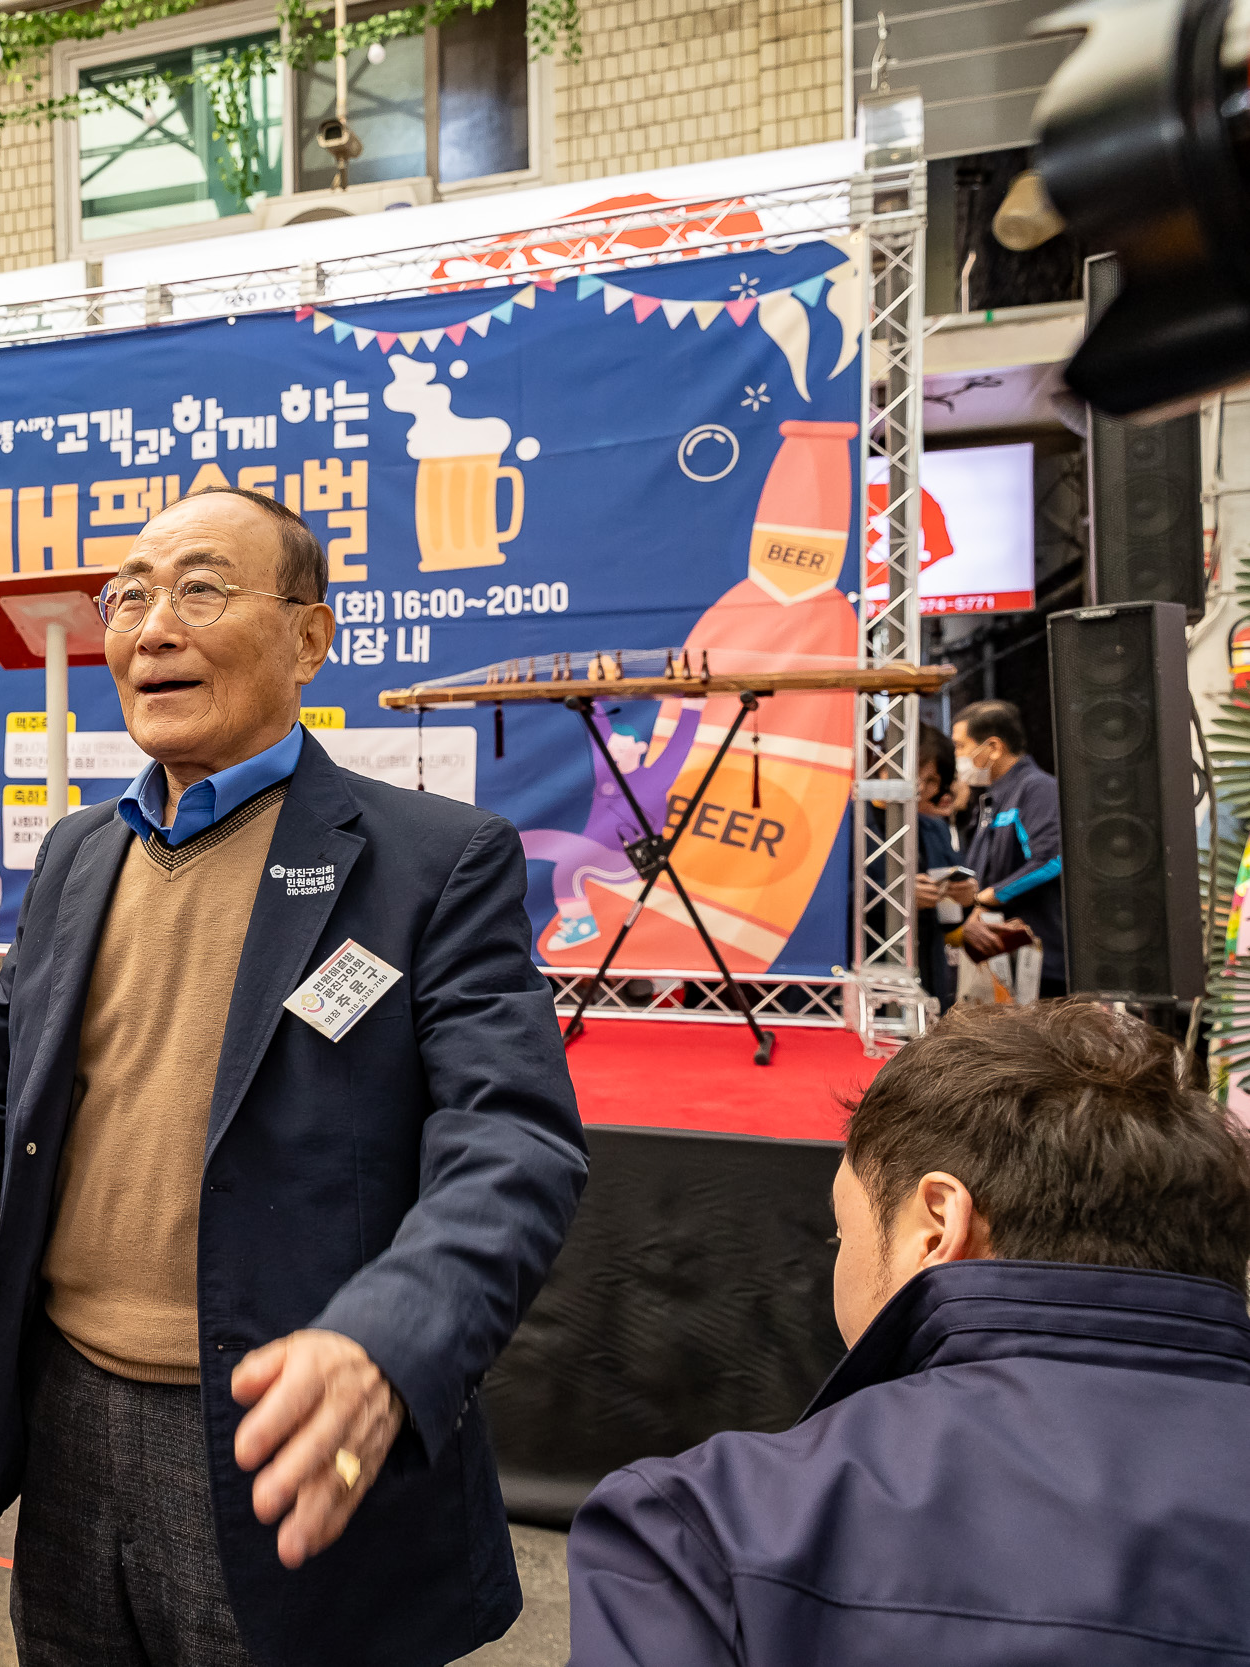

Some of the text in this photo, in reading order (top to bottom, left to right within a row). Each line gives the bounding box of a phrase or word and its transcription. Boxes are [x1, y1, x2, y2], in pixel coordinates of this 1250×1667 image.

[57, 407, 177, 467] 고객과
[172, 394, 277, 460] 함께
[281, 380, 370, 449] 하는
[768, 544, 824, 569] BEER
[335, 582, 569, 625] (화) 16:00~20:00
[396, 624, 431, 664] 내
[666, 795, 785, 858] BEER
[286, 865, 335, 877] 광진구의회
[286, 874, 335, 887] 민원해결방
[313, 952, 355, 992] 민원해결방
[322, 958, 366, 999] 광진구의회
[324, 1009, 341, 1025] 의장
